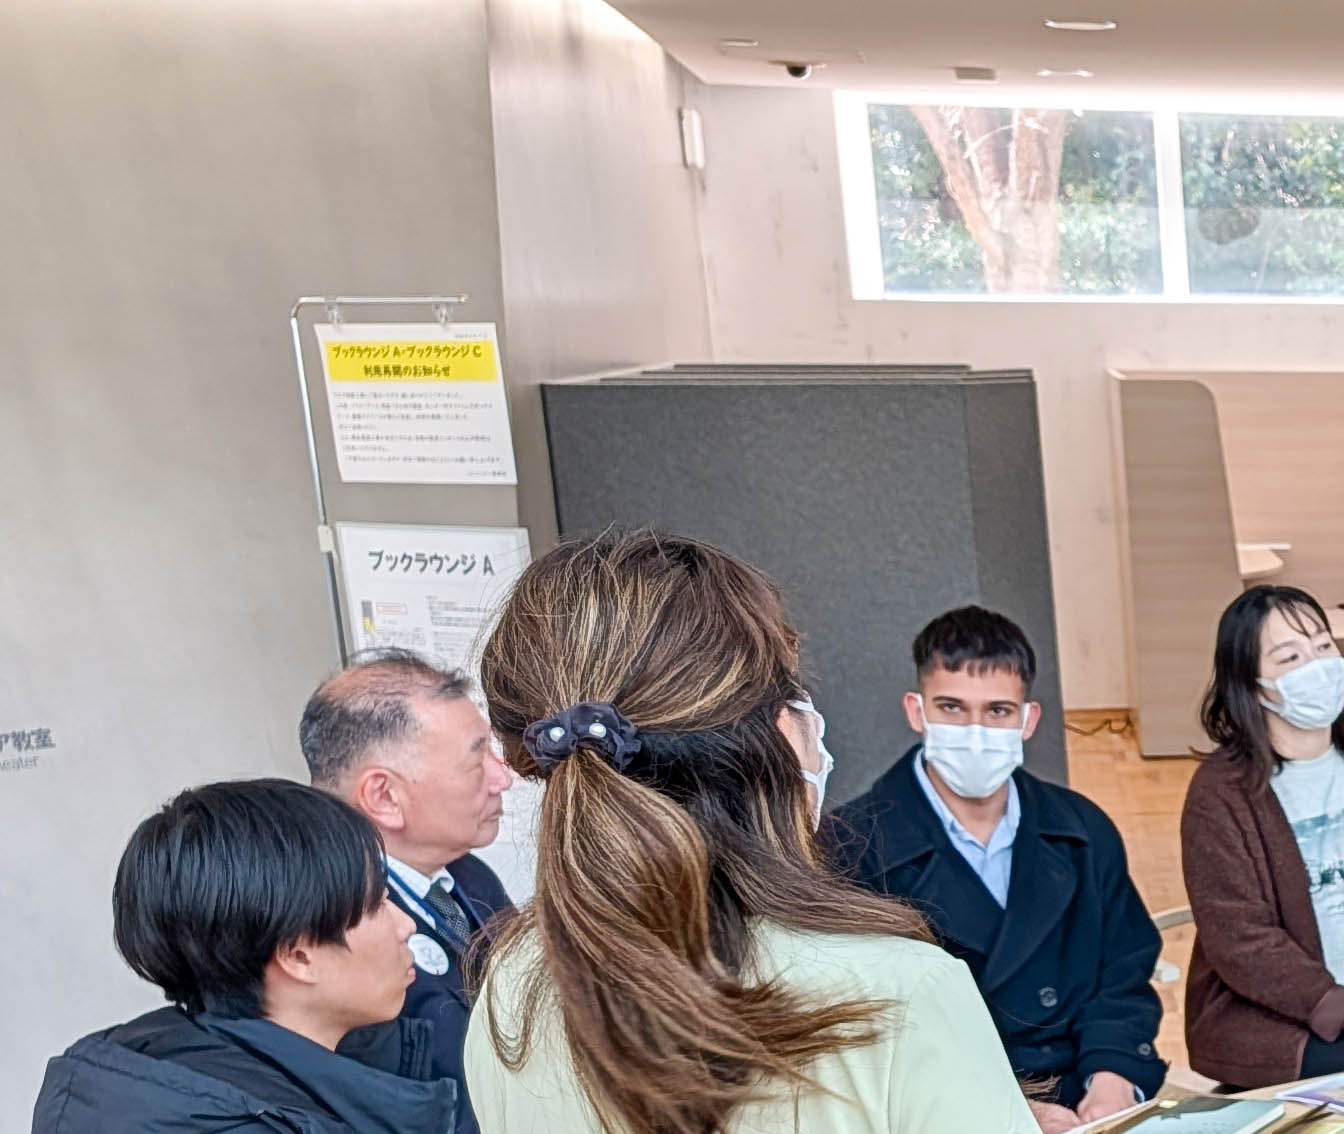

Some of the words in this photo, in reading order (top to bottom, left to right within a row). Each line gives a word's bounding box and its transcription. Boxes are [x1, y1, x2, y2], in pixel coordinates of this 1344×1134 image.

[368, 550, 477, 575] ブックラウンジ
[483, 555, 495, 576] A
